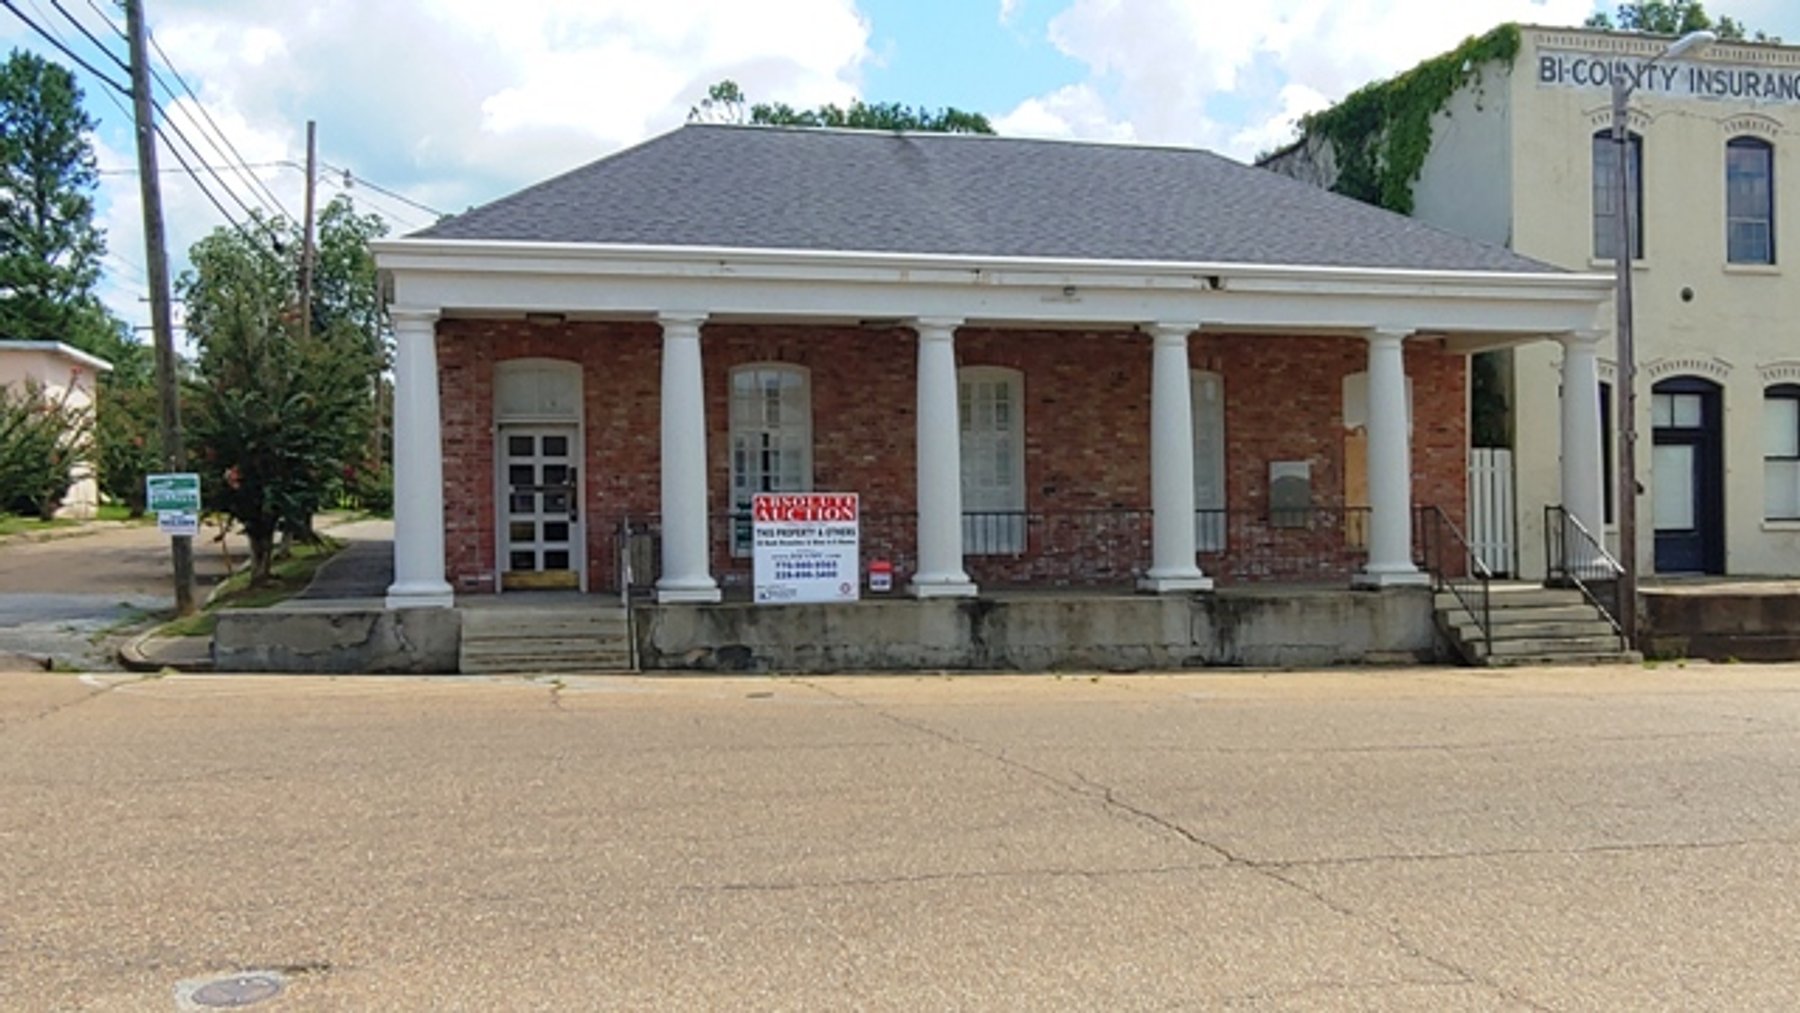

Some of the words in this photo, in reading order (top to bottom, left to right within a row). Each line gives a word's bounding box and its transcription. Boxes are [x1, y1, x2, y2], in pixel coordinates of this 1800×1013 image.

[1539, 56, 1679, 91] BI-COUNTY
[757, 495, 856, 507] ABSOLUTE
[757, 506, 855, 520] AUCTION
[756, 528, 774, 538] THIS
[776, 528, 816, 538] PROPERTY
[825, 527, 856, 538] OTHERS
